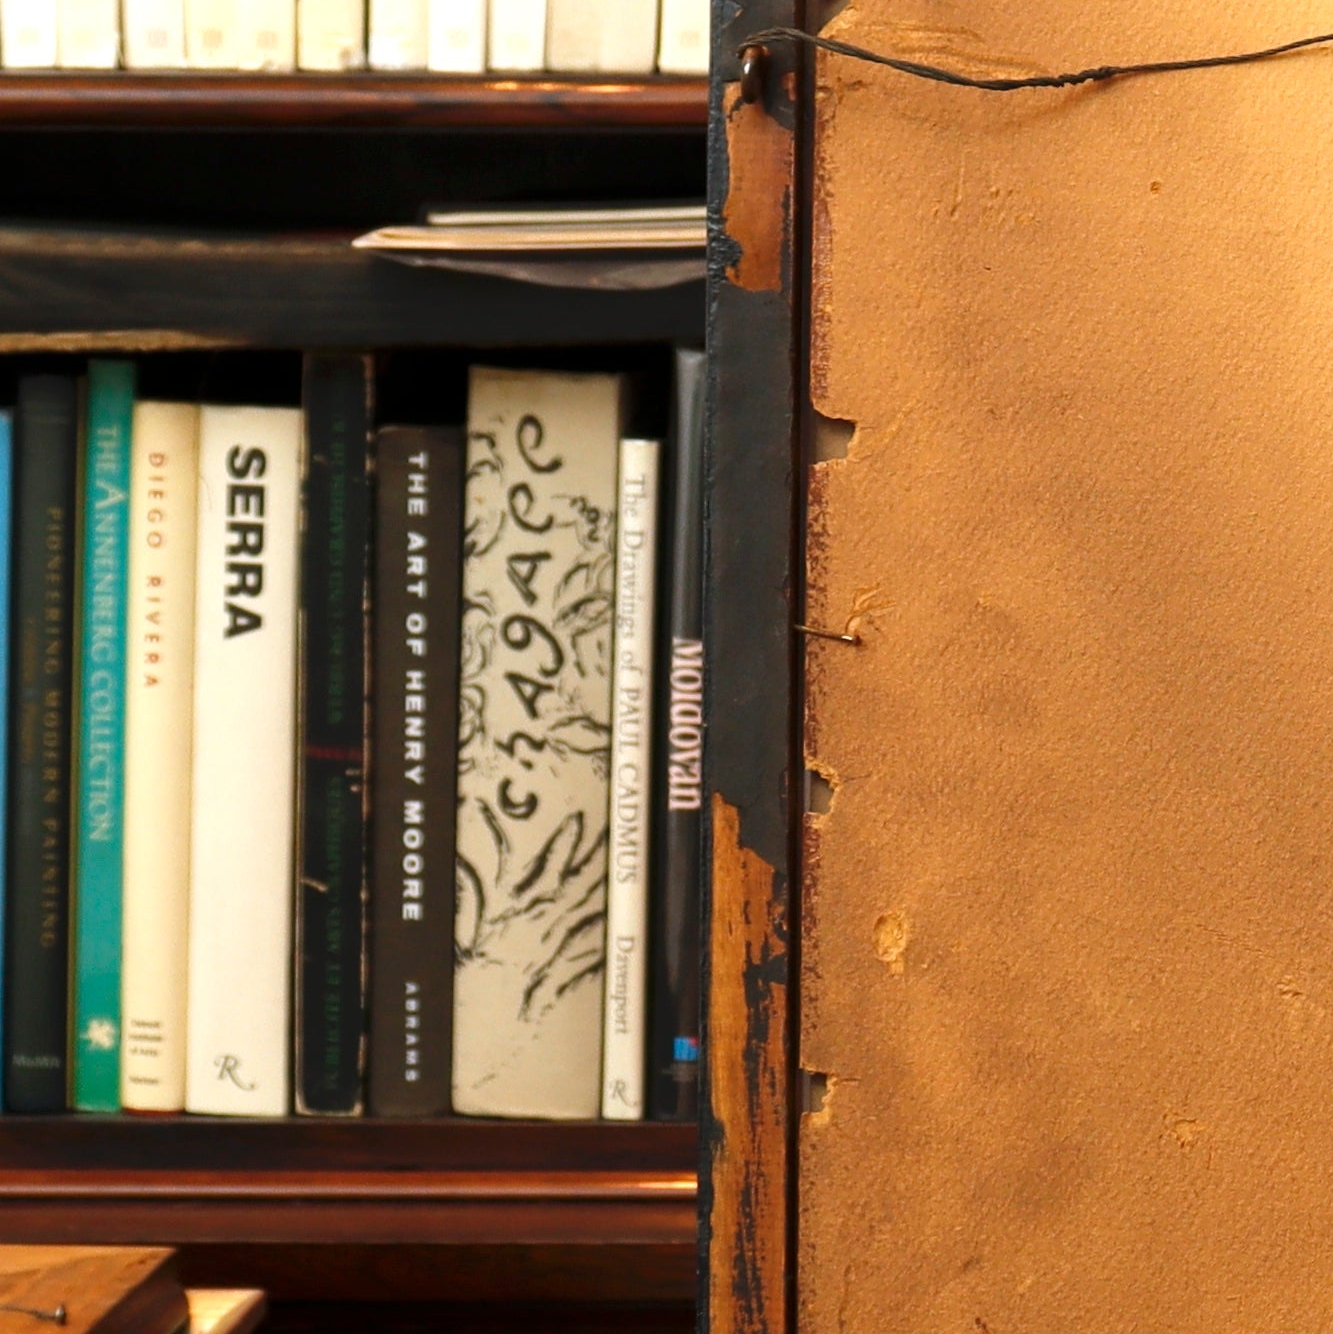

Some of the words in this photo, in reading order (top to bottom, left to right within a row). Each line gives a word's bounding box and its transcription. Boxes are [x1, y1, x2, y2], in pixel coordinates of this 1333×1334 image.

[93, 424, 118, 475] THE
[146, 452, 167, 549] DIEGO
[407, 452, 427, 517] THE
[622, 472, 648, 519] The
[88, 478, 126, 663] ANNENBERG
[223, 443, 268, 641] SERRA
[405, 530, 426, 599] ART
[617, 527, 645, 639] Drawings
[143, 575, 166, 688] RIVERA
[404, 613, 425, 656] OF
[618, 648, 645, 677] of
[88, 667, 117, 841] COLLECTION
[403, 669, 425, 785] HENRY
[616, 686, 642, 753] PAUL
[667, 635, 704, 812] Moldovan
[401, 799, 423, 921] MOORE
[614, 761, 642, 885] CADMUS
[404, 981, 421, 1083] ABRAMS
[611, 934, 635, 1035] Davenport
